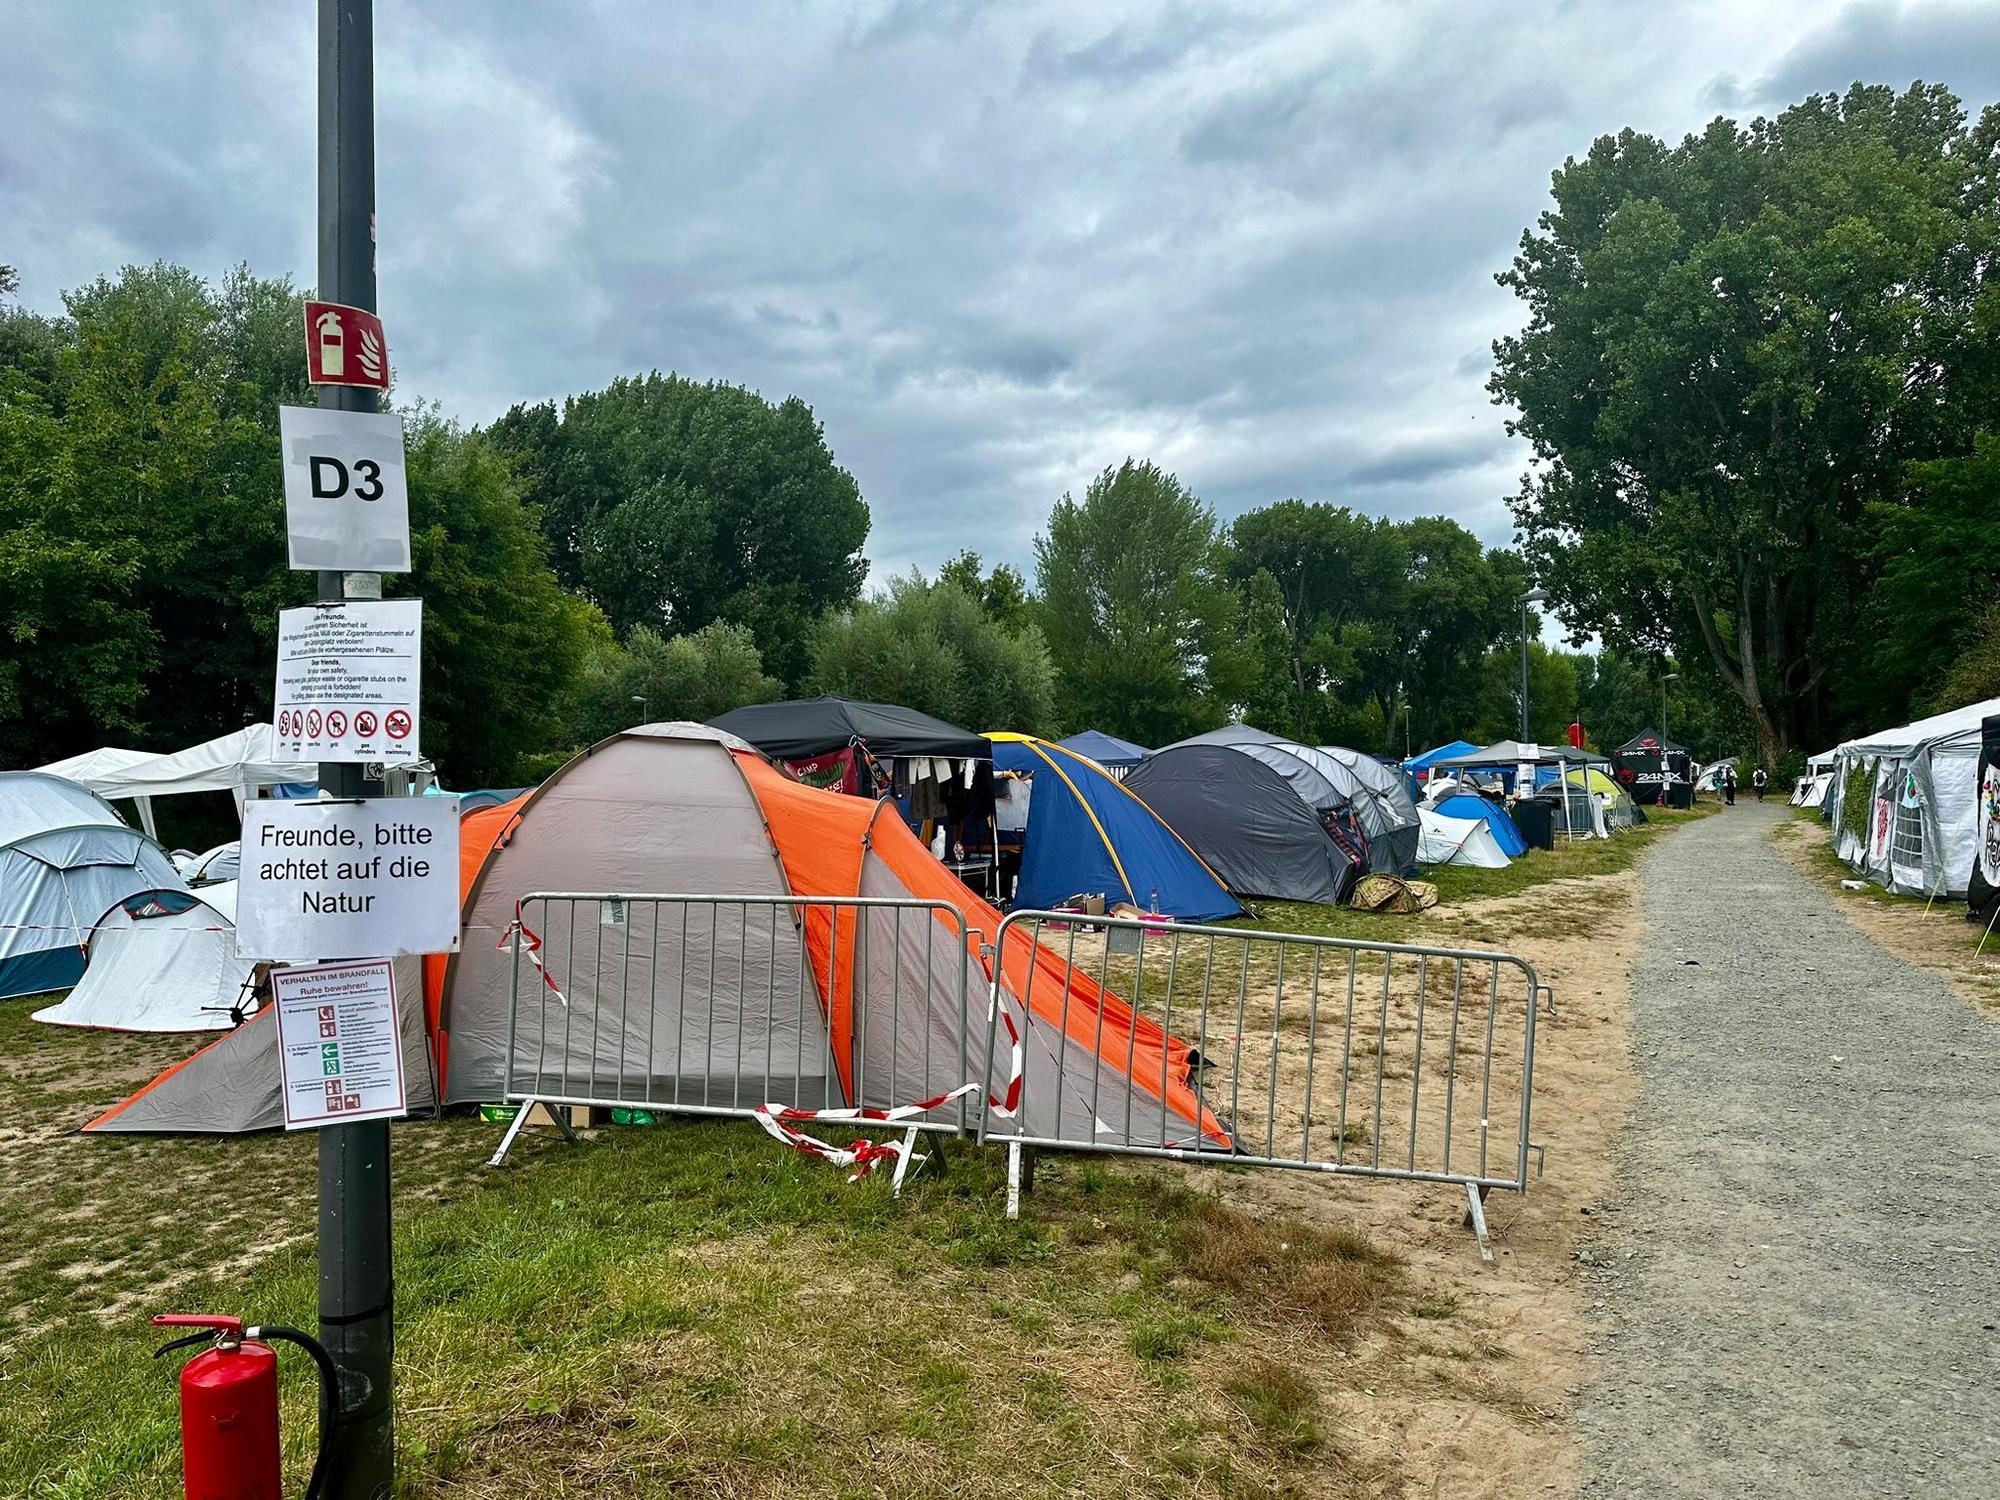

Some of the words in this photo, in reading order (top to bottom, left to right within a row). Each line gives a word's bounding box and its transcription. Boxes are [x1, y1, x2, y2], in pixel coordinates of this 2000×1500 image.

[310, 456, 384, 501] D3
[798, 763, 818, 777] CAMP
[261, 824, 363, 848] Freunde,
[376, 823, 432, 845] bitte
[260, 858, 328, 880] achtet
[337, 856, 381, 880] auf
[389, 856, 430, 878] die
[302, 891, 376, 914] Natur
[280, 974, 326, 985] VERHALTEN
[340, 968, 386, 980] BRANDFALL
[300, 986, 322, 996] Ruhe
[324, 981, 368, 993] bewahren!
